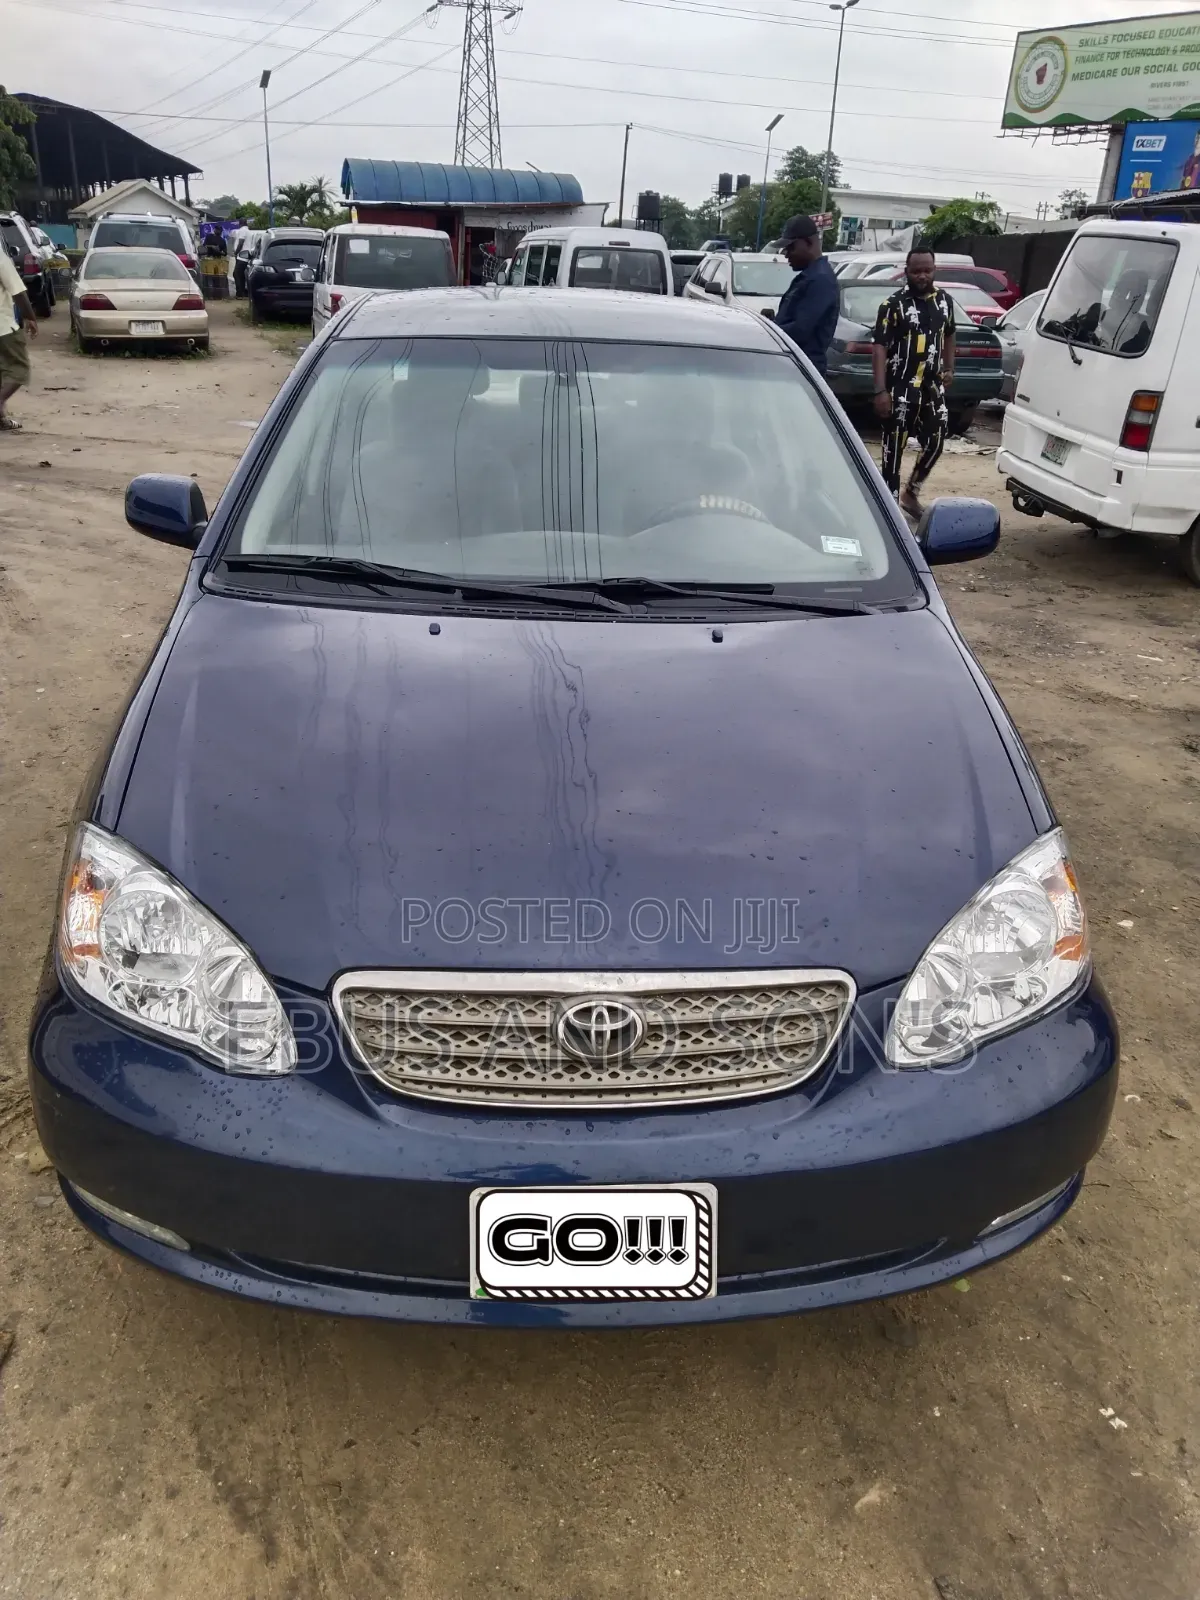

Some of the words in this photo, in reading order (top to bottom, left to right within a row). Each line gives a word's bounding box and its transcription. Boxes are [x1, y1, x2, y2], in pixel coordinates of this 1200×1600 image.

[1078, 35, 1109, 48] SKILLS
[1111, 29, 1156, 44] FOCUSED
[1075, 52, 1105, 65] FINANCE
[1106, 51, 1121, 61] FOR
[1122, 46, 1170, 59] TECHNOLOGY
[1172, 45, 1178, 55] &
[1071, 68, 1118, 81] MEDICARE
[1121, 66, 1141, 77] OUR
[1143, 63, 1178, 75] SOCIAL
[1136, 138, 1164, 148] 1XBET
